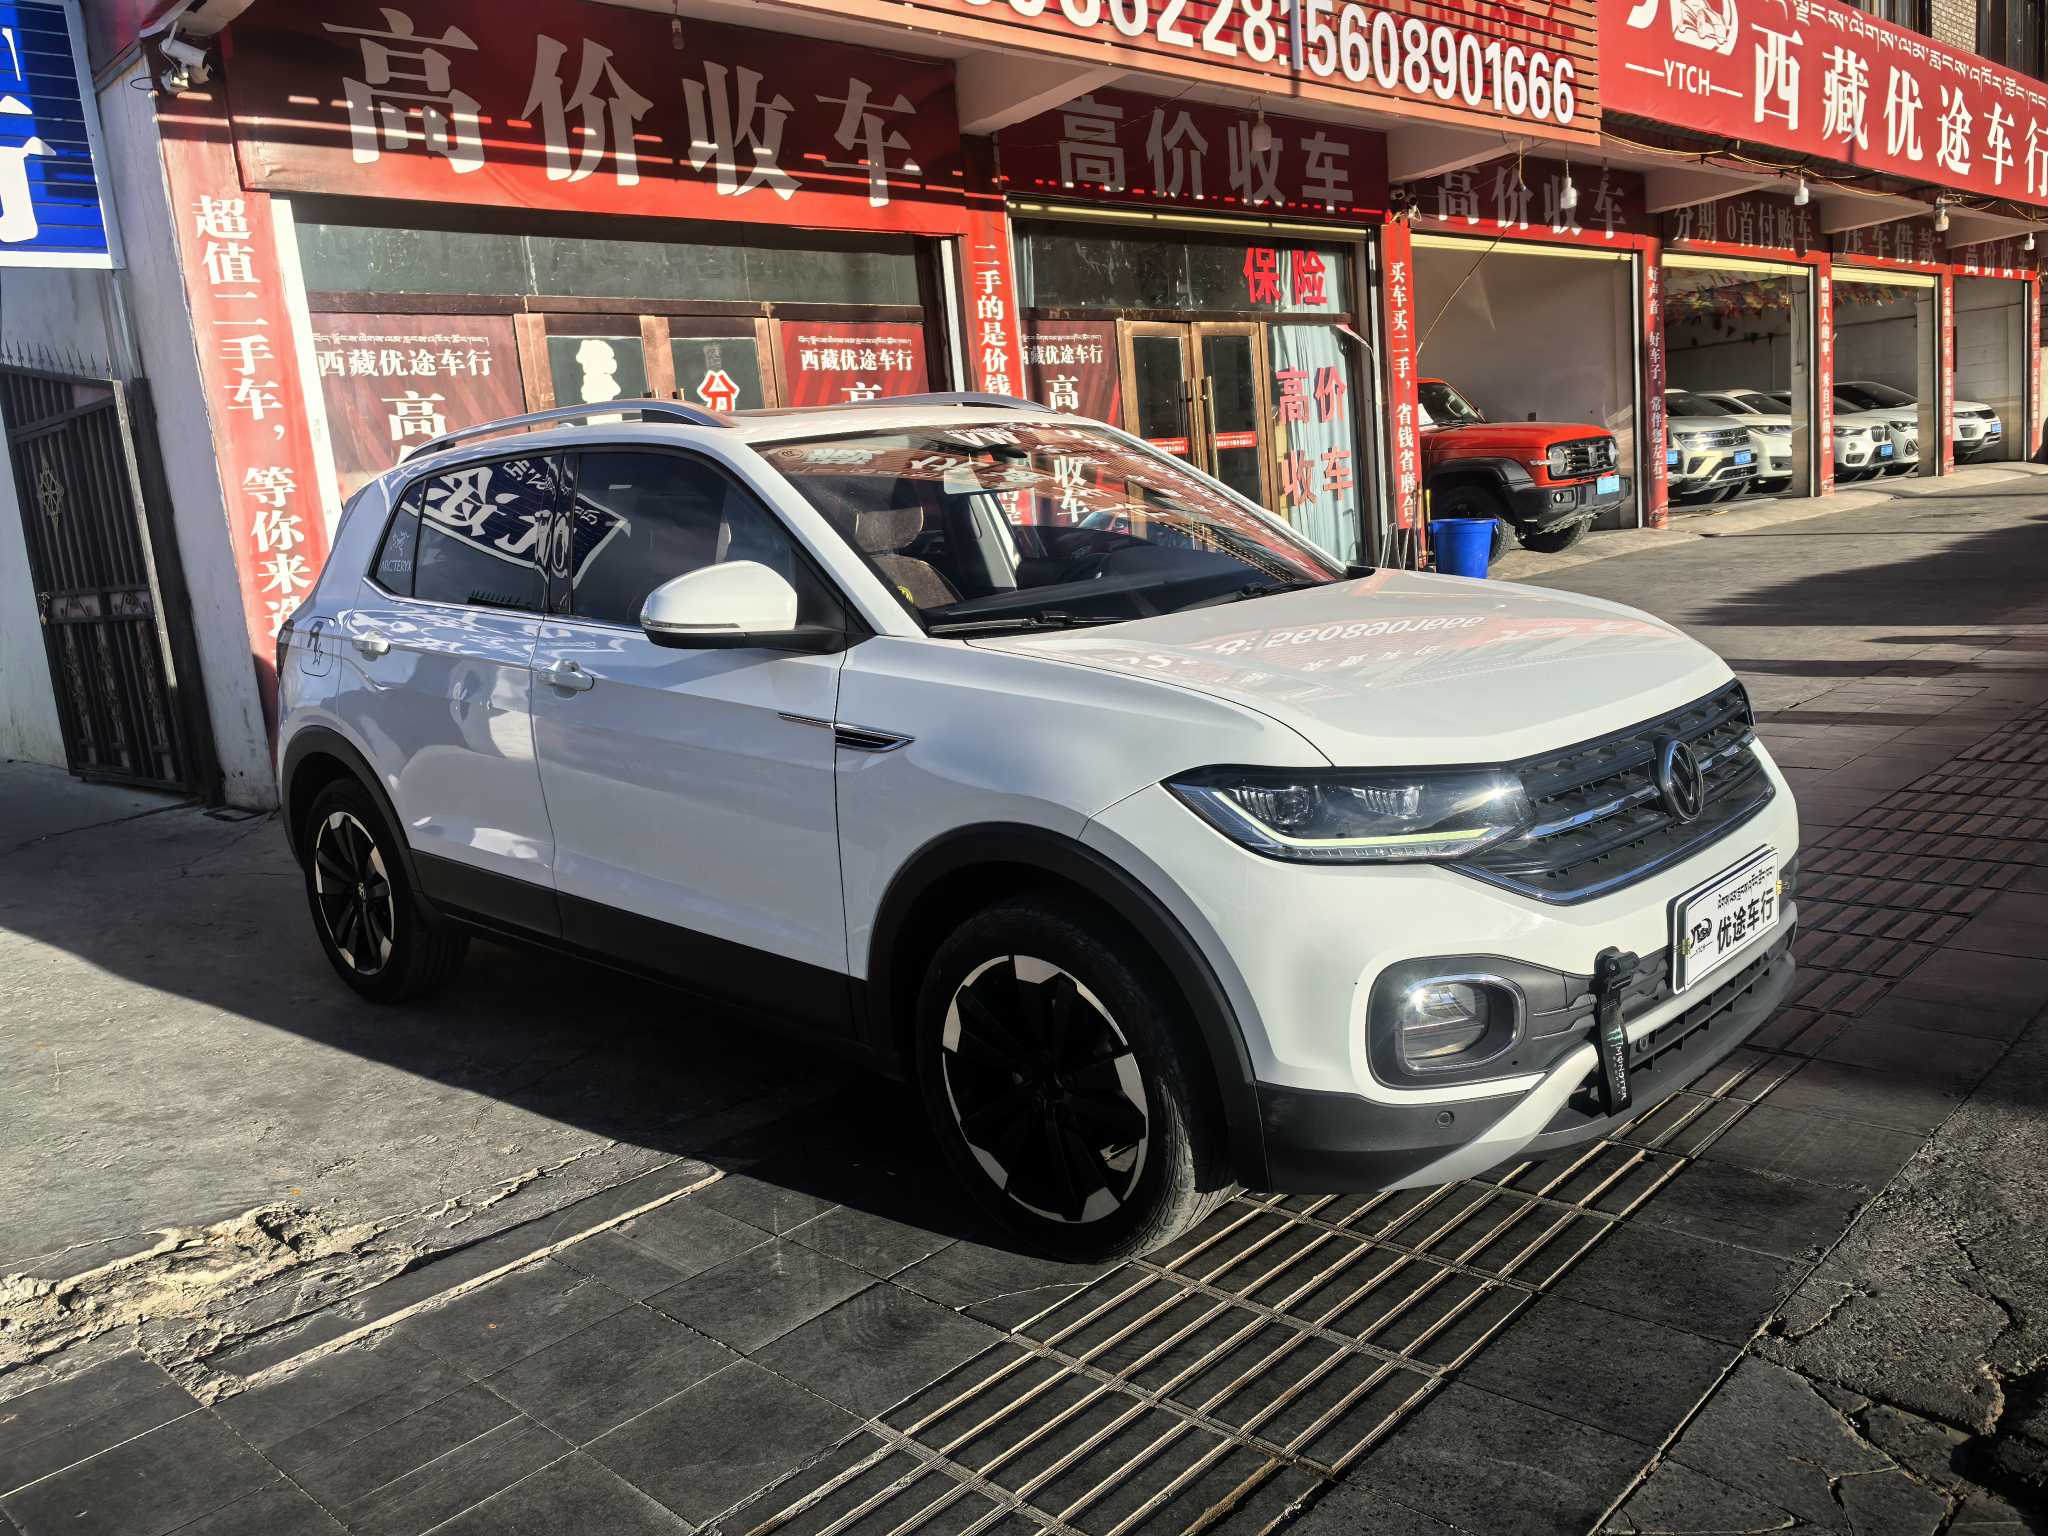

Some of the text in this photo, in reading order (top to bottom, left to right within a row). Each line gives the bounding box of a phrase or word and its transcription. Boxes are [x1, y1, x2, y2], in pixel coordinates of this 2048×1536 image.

[1664, 59, 1711, 96] YTCH
[323, 8, 922, 207] 高价收车
[1752, 23, 2048, 198] 西藏优途车行
[1055, 94, 1353, 214] 高价收车
[1437, 165, 1626, 239] 高价收车
[1243, 247, 1327, 304] 保险
[319, 349, 493, 376] 西藏优途车行
[801, 348, 913, 371] 西藏优途车行
[1276, 366, 1348, 424] 高价
[1280, 447, 1352, 506] 收车
[1716, 887, 1775, 954] 优途车行
